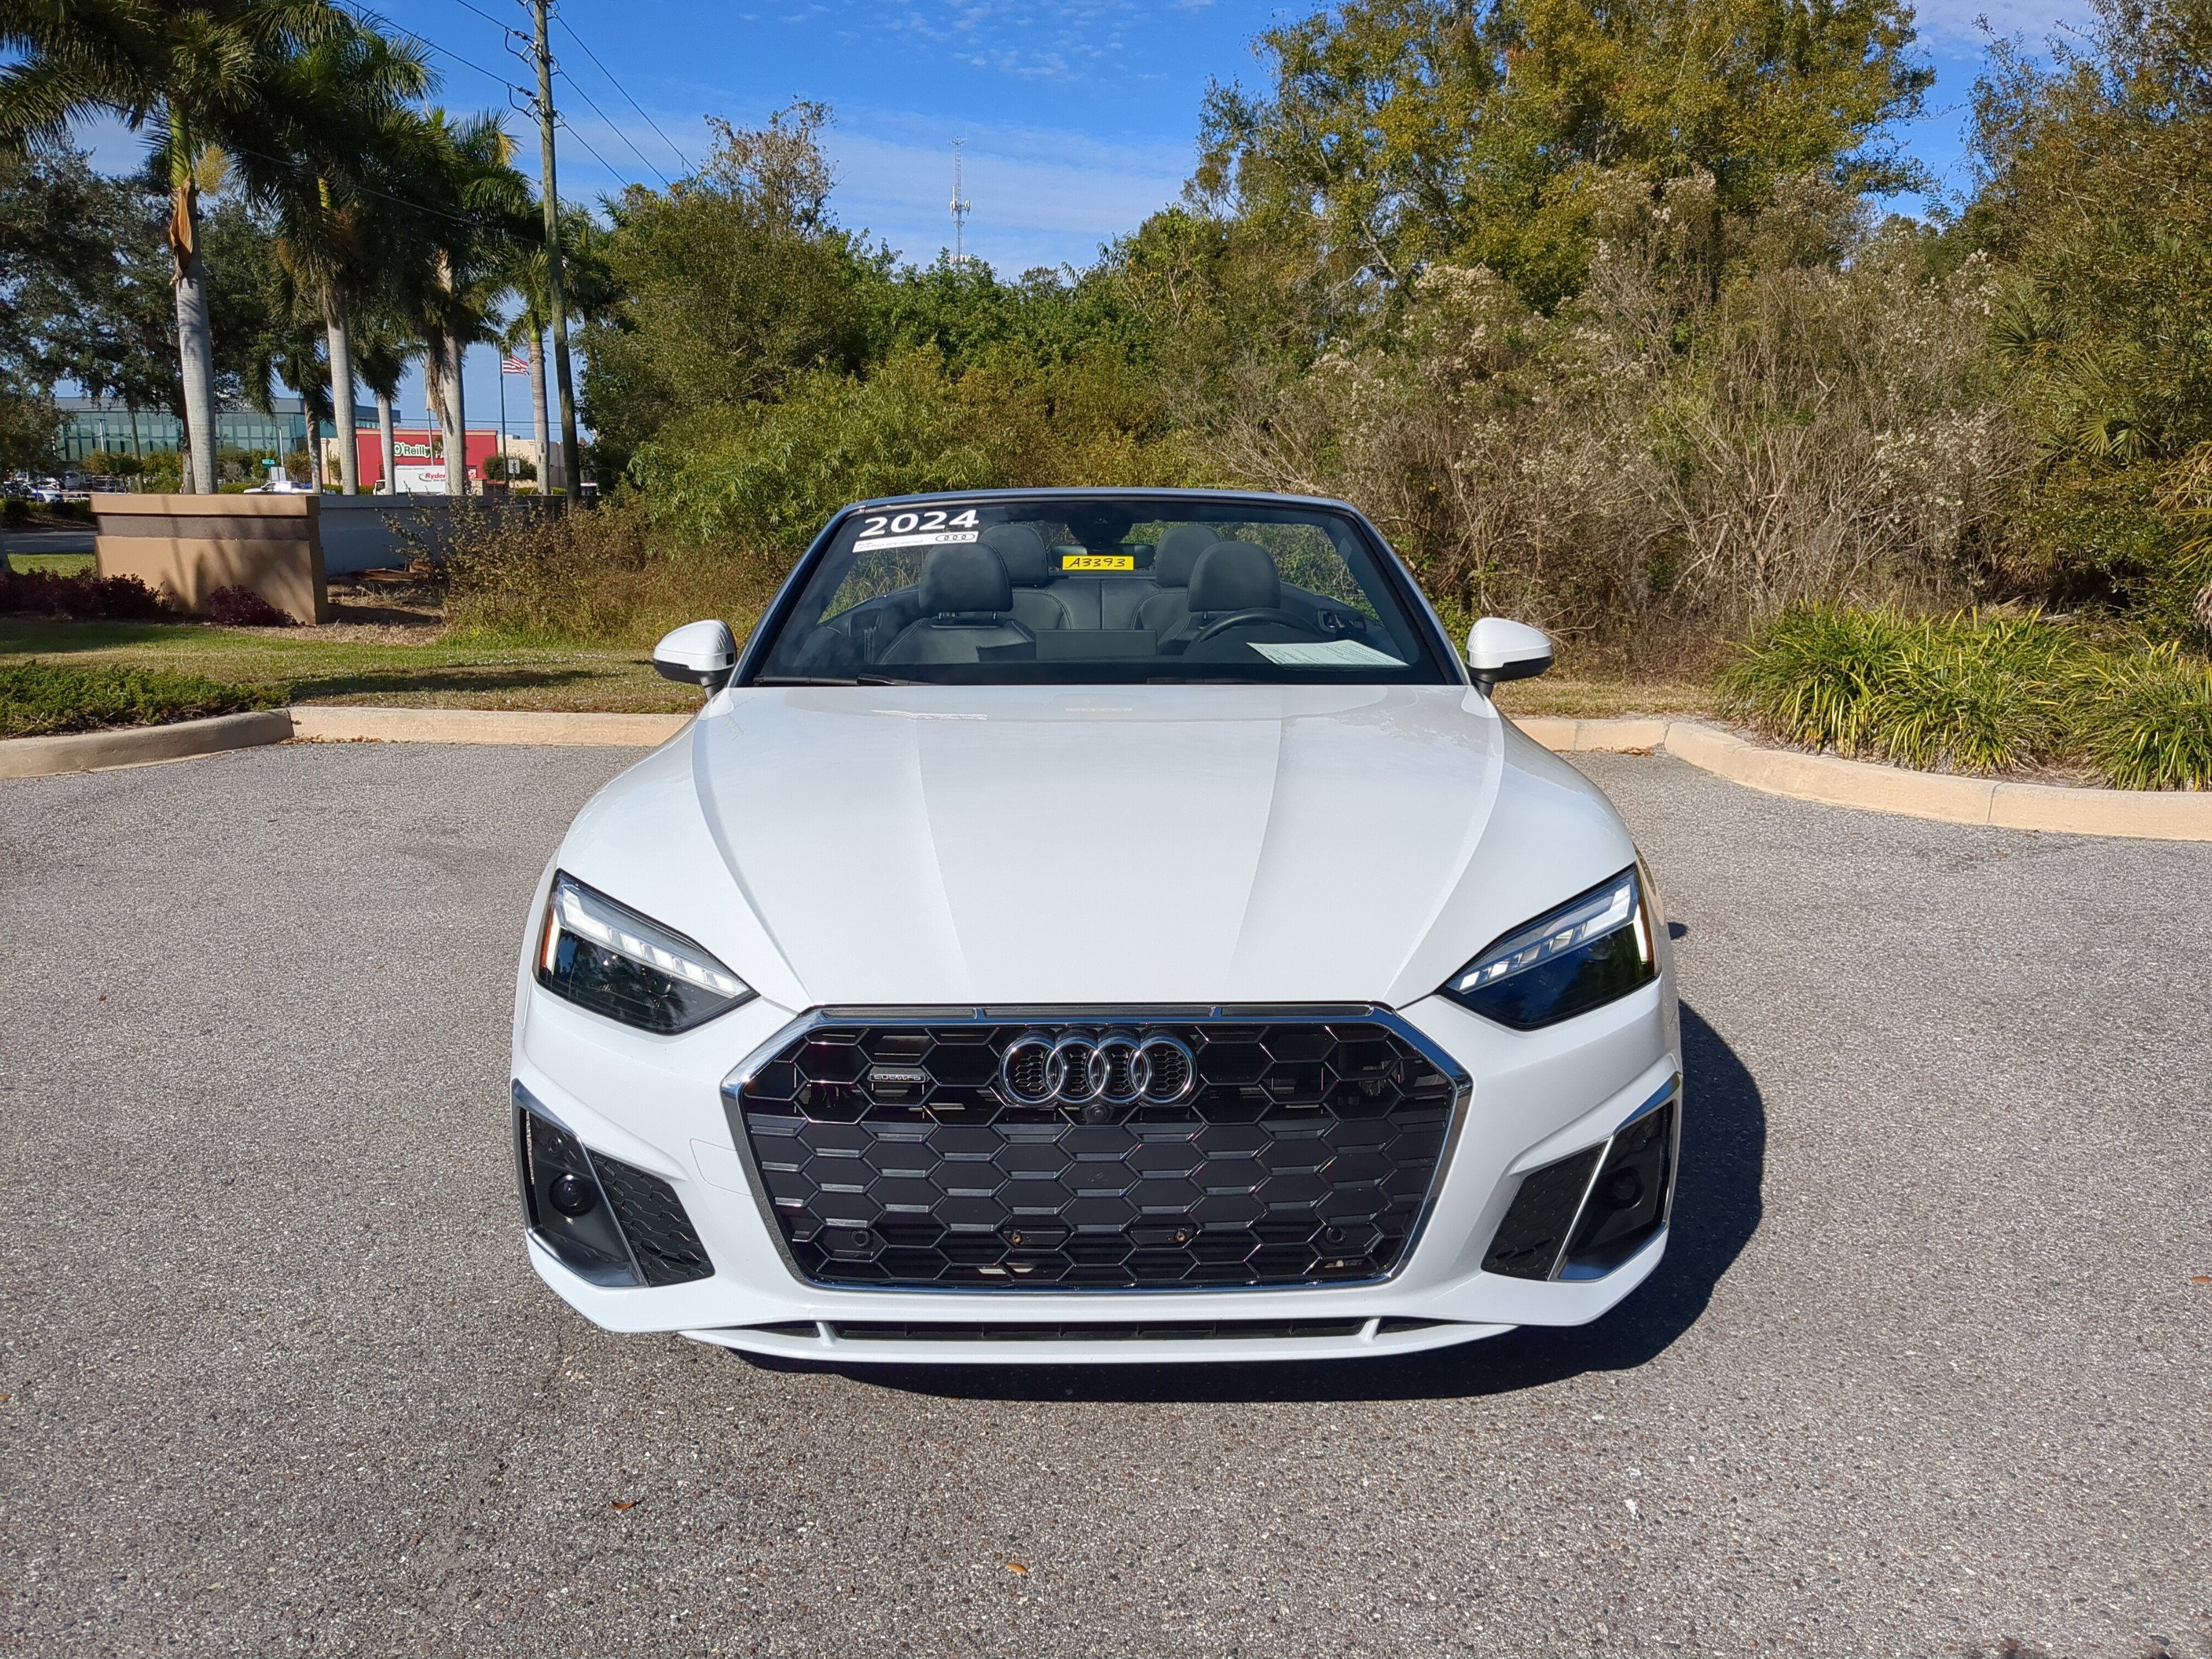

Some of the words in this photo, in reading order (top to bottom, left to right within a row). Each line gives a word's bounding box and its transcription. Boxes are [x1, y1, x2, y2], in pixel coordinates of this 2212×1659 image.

[394, 442, 431, 458] O'Reilly
[859, 510, 979, 537] 2024
[1069, 557, 1126, 568] A3393
